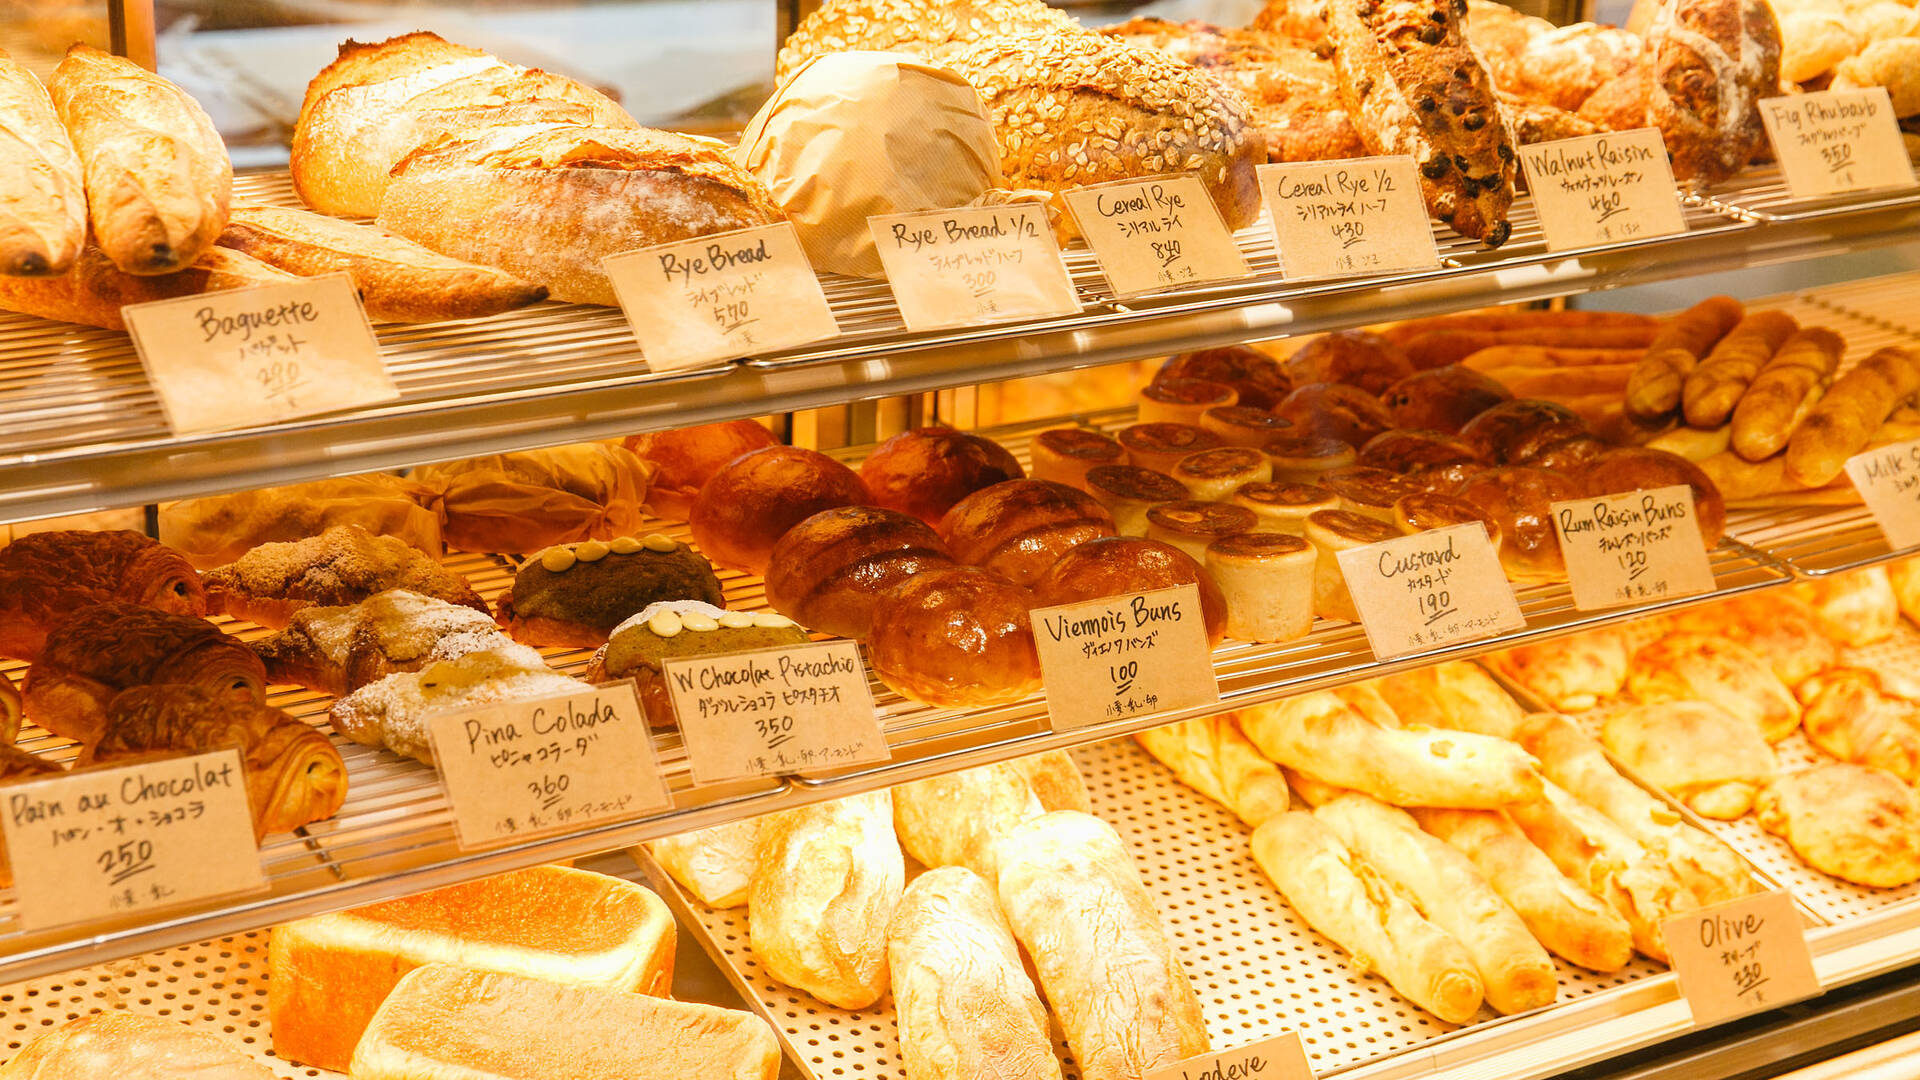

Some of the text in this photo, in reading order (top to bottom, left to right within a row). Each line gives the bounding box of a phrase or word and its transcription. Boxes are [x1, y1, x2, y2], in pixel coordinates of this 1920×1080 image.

[1770, 96, 1878, 130] Fig Rhubarb
[1529, 139, 1654, 177] Walnut Raisin
[1821, 143, 1851, 163] 350
[1278, 169, 1397, 199] Cereal Rye 1/2
[1097, 185, 1185, 217] Cereal Rye
[1589, 192, 1621, 213] 460
[892, 214, 1040, 253] Rye Bread 1/2
[1331, 222, 1364, 240] 430
[659, 239, 772, 287] Rye Bread
[1151, 240, 1181, 259] 840
[962, 271, 996, 289] 300
[195, 300, 319, 343] Baguette
[713, 301, 749, 326] 570
[256, 362, 300, 386] 290
[1560, 495, 1686, 544] Rum Raisin Buns
[1378, 535, 1460, 578] Custard
[1618, 551, 1647, 570] 120
[1418, 590, 1450, 615] 190
[1044, 596, 1182, 642] Viennois Buns
[673, 668, 695, 693] W
[778, 652, 855, 687] Pistachio
[1110, 660, 1138, 683] 100
[464, 697, 620, 754] Pina Colada
[755, 715, 794, 738] 350
[9, 762, 233, 828] Pain au Chocolat
[528, 774, 570, 800] 360
[97, 839, 152, 874] 250
[1700, 914, 1765, 948] Olive
